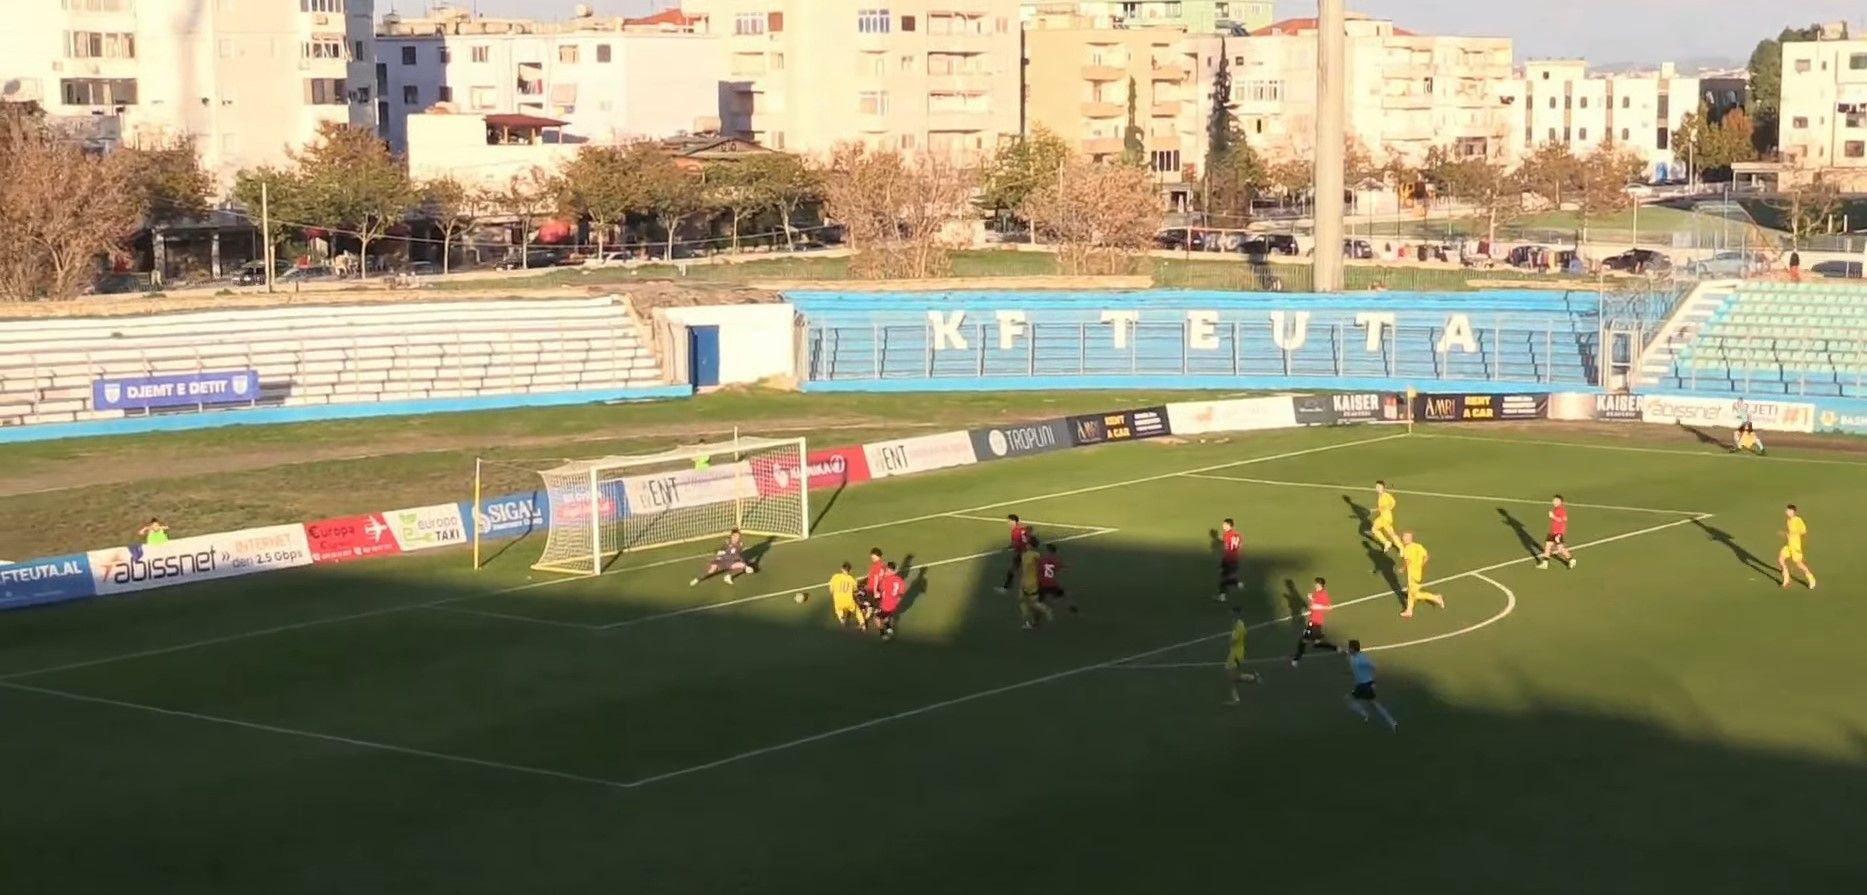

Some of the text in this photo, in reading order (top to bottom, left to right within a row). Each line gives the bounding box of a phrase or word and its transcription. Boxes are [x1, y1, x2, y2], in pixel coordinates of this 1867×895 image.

[927, 309, 1478, 353] KF TEUTA
[127, 380, 228, 399] DJEMT E DETIT
[1333, 394, 1379, 412] KAISER
[488, 500, 542, 522] SIGAL
[435, 530, 459, 541] TAXI
[0, 559, 83, 586] FTEUTA.AL
[114, 545, 217, 585] abissnet
